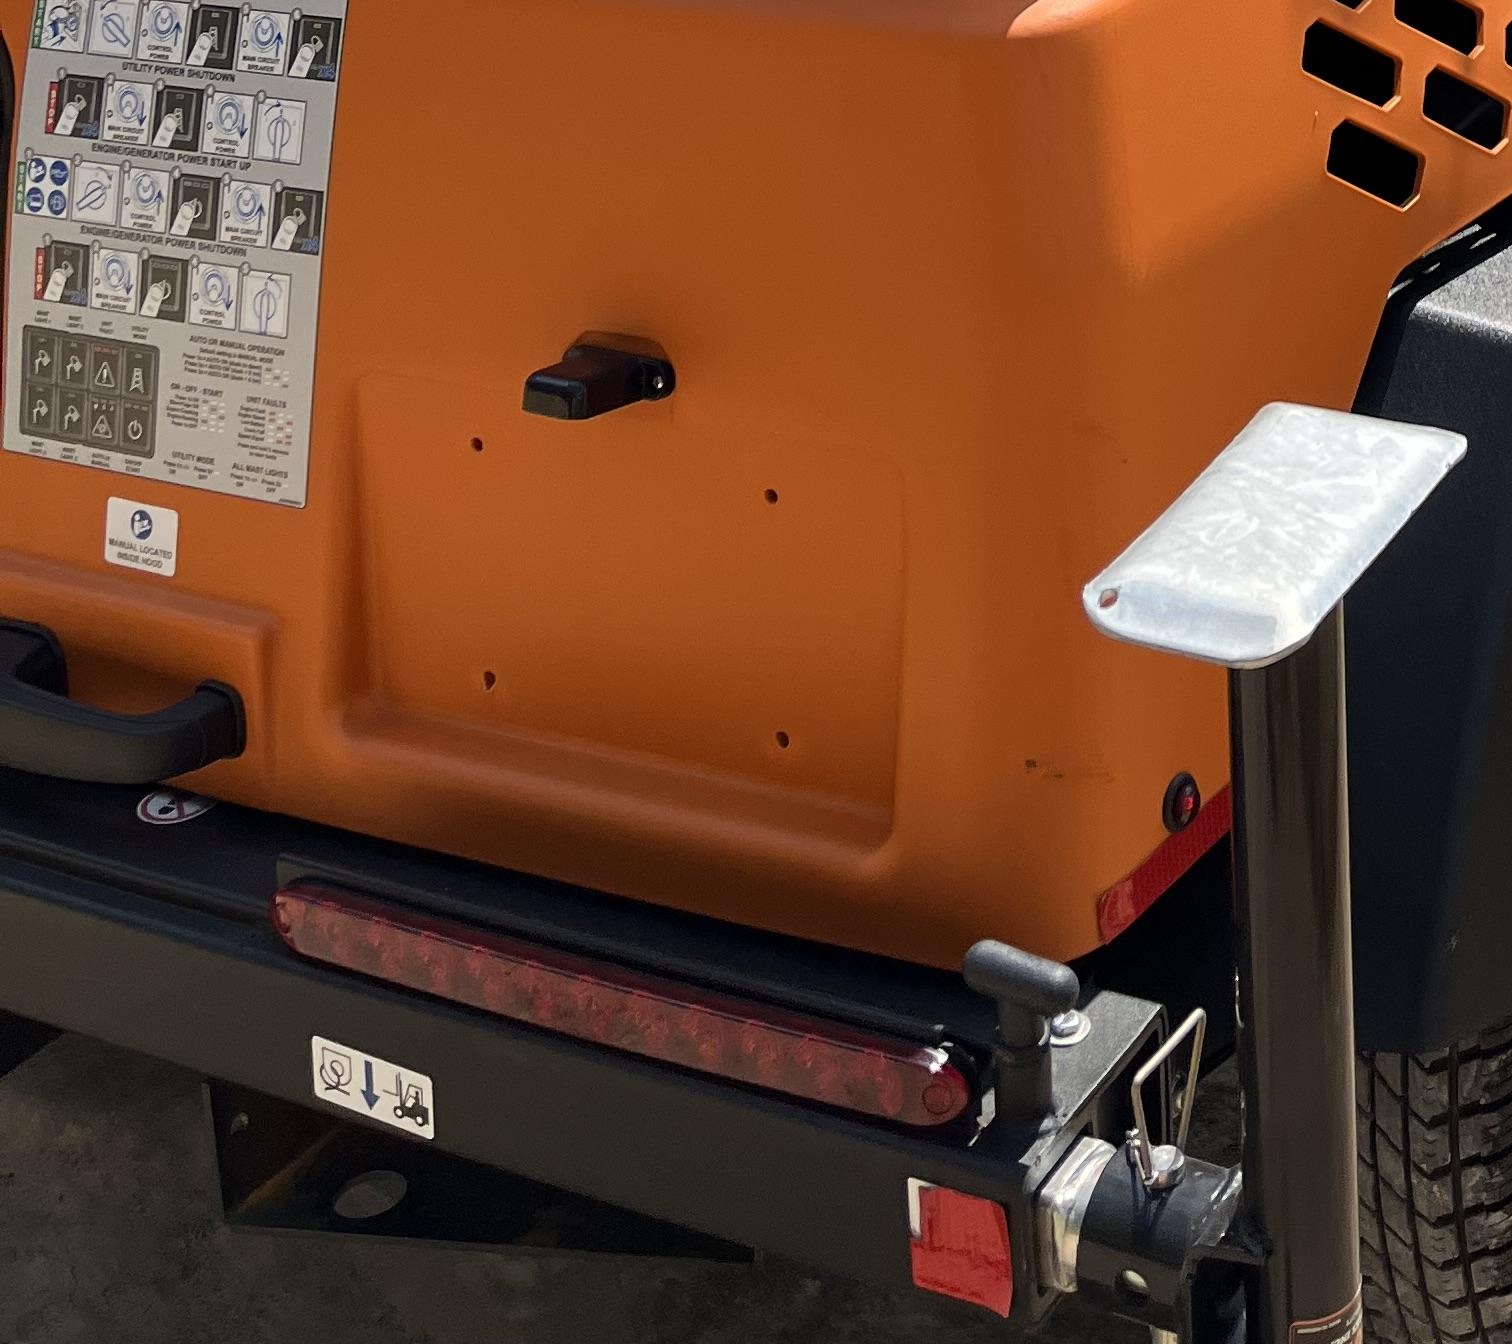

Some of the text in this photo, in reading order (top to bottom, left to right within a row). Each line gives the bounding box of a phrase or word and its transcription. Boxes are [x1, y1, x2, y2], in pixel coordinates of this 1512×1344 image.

[122, 62, 235, 82] UTILITY POWER SHUTDOWN
[177, 154, 208, 167] POWER
[210, 159, 237, 170] START
[239, 161, 251, 171] UP
[165, 238, 195, 250] POWER
